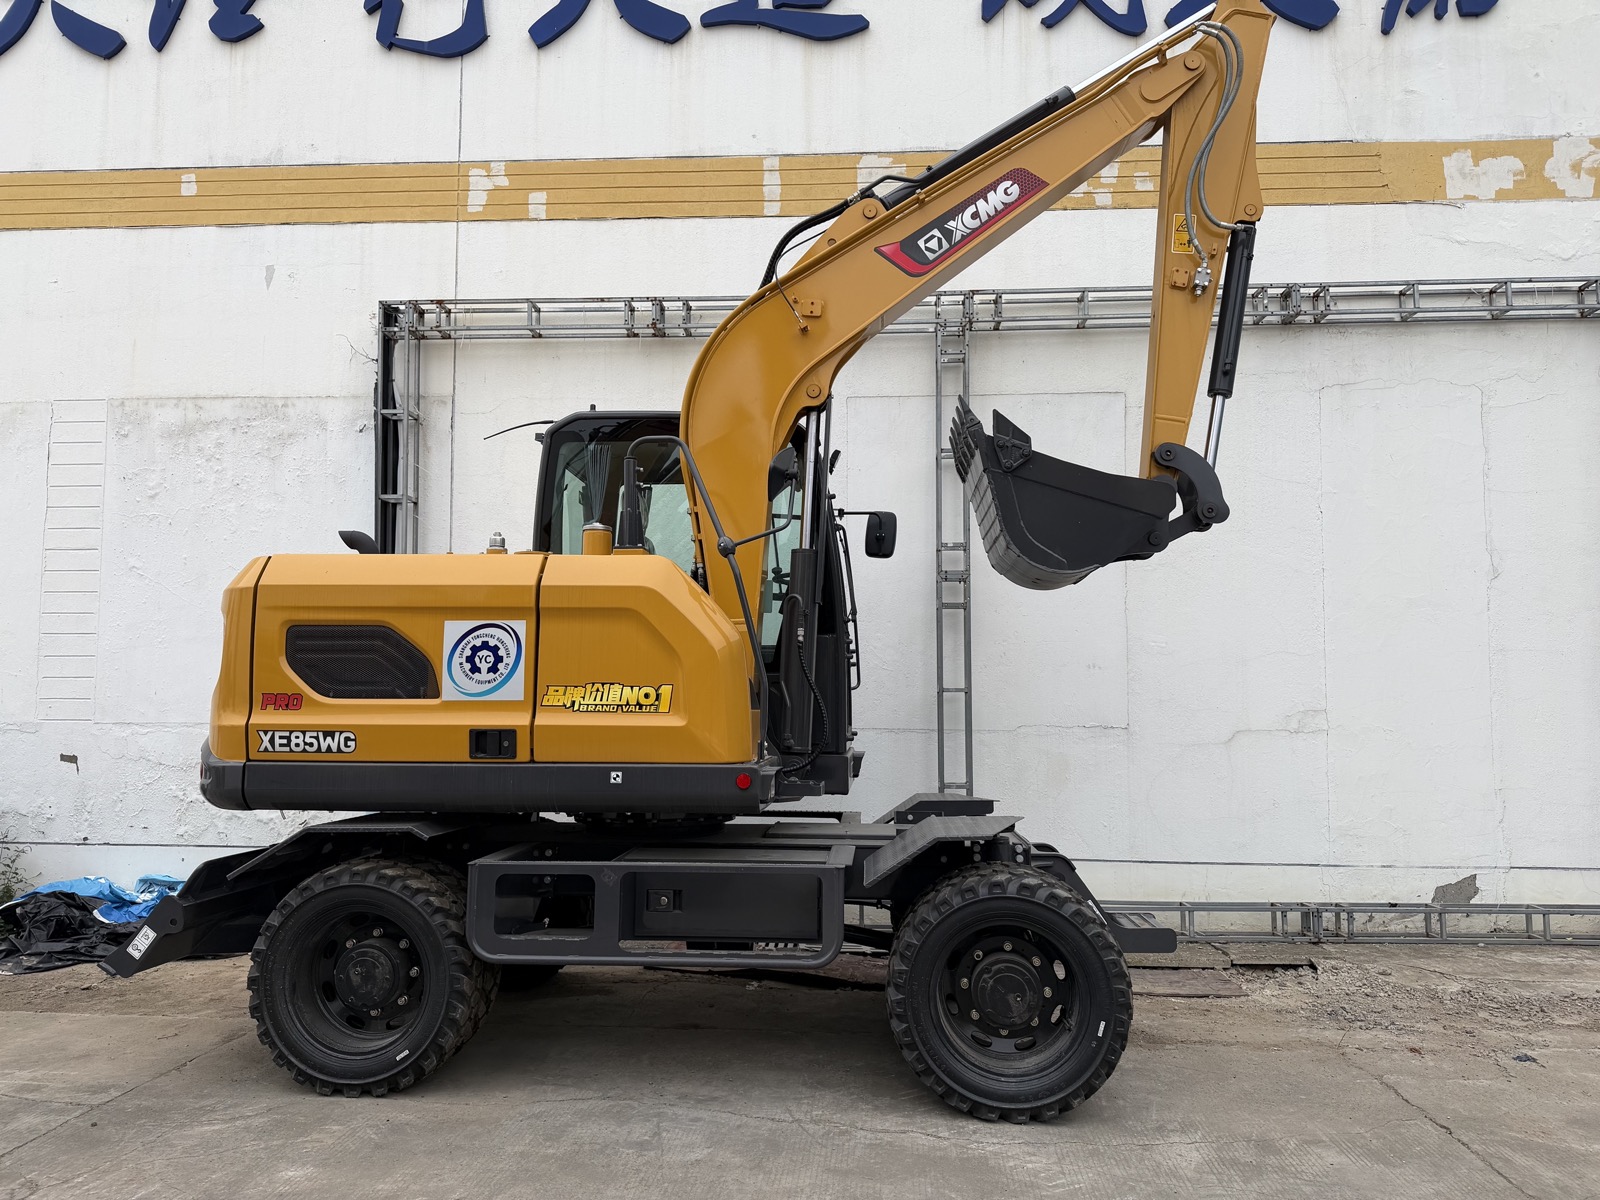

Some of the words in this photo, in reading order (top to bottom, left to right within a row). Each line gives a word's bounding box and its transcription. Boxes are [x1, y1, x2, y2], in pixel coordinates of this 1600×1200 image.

[944, 180, 1020, 245] XCMG
[477, 654, 492, 664] YC
[459, 661, 475, 682] MACHINERY
[475, 677, 499, 685] EQUIPMENT
[260, 693, 303, 710] PRO
[580, 704, 617, 712] BRAND
[257, 730, 356, 753] XE85WG
